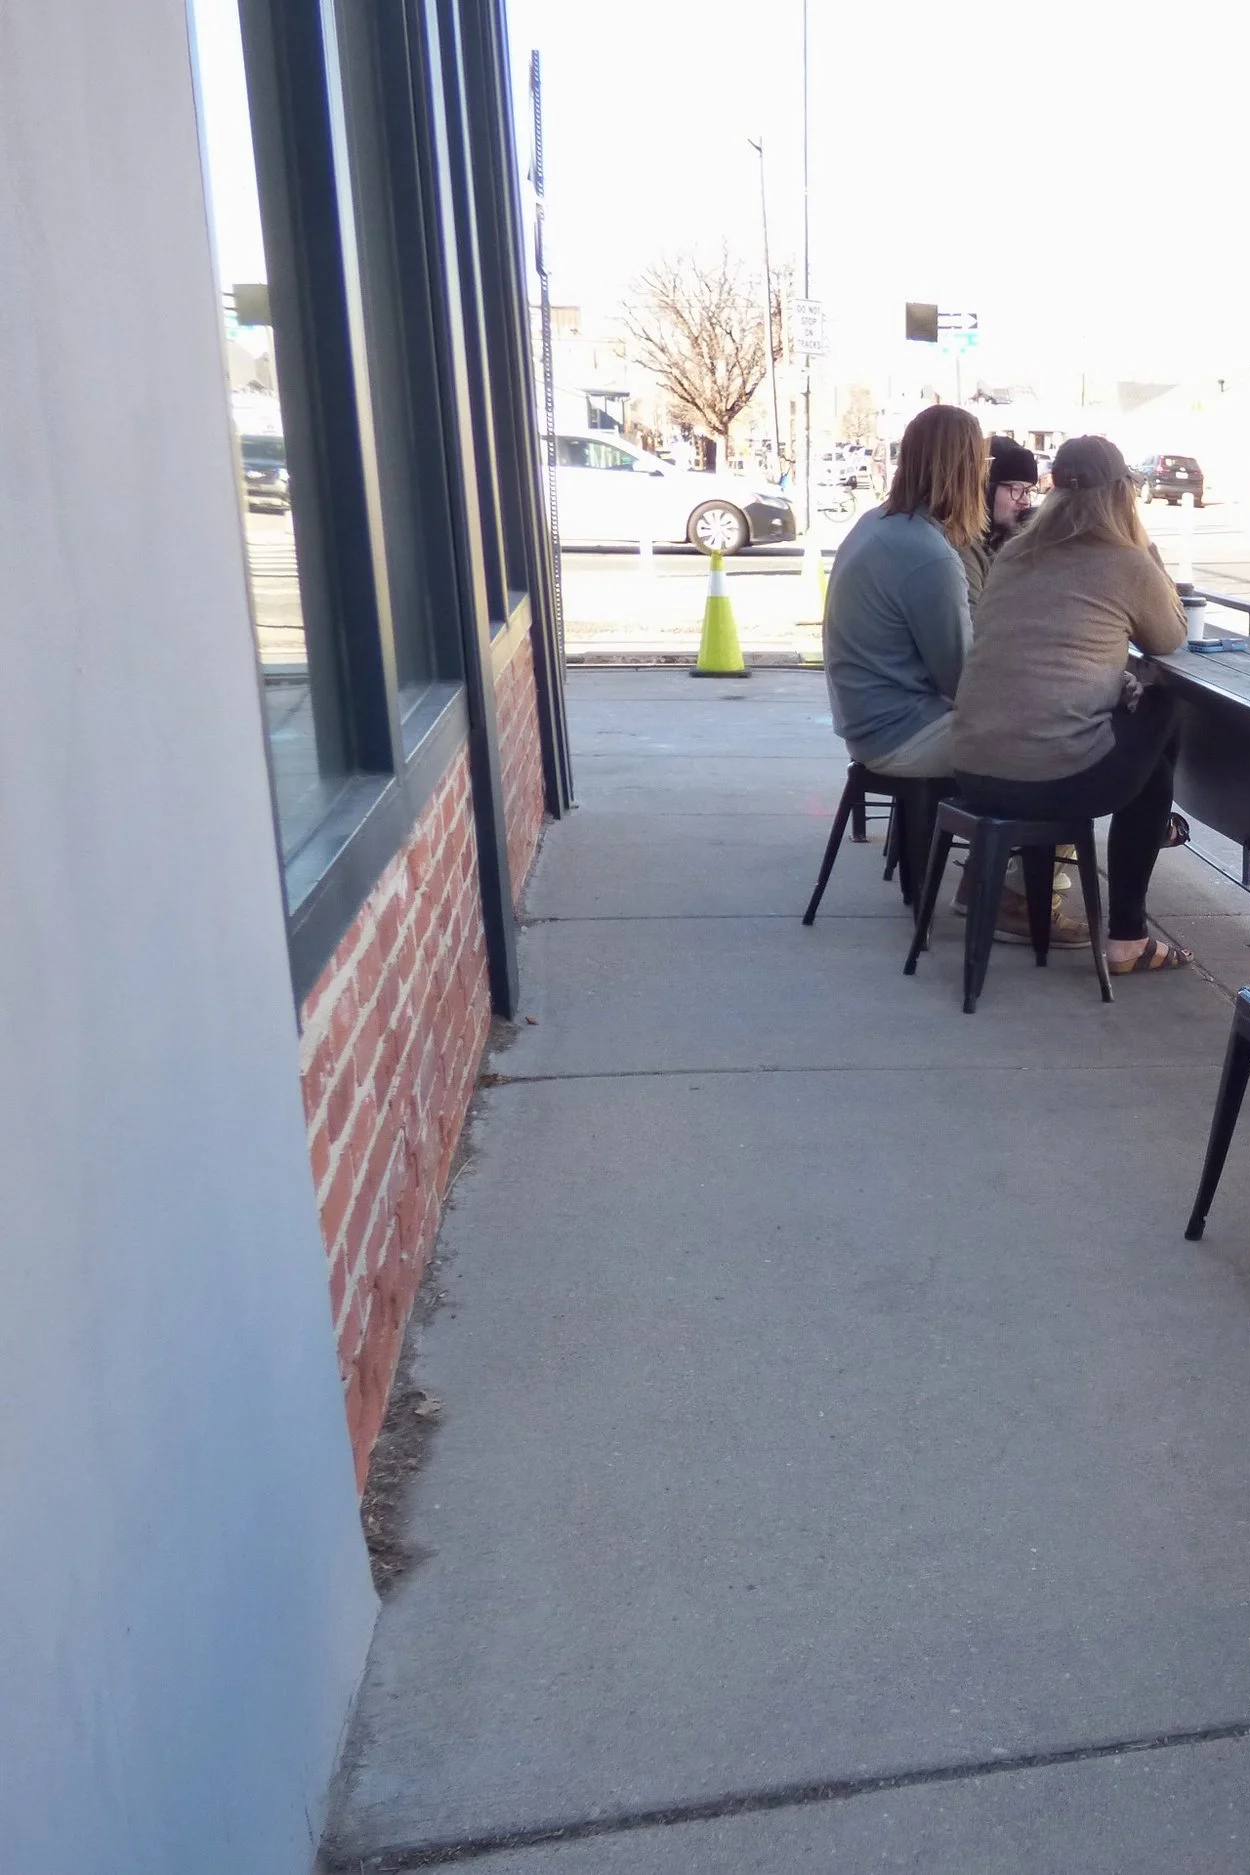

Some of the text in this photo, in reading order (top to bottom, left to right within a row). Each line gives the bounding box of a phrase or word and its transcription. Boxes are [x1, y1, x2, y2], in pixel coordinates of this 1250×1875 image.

[797, 304, 821, 315] DO NOT
[800, 316, 817, 326] STOP
[805, 328, 814, 337] ON
[797, 339, 821, 349] TRACKS
